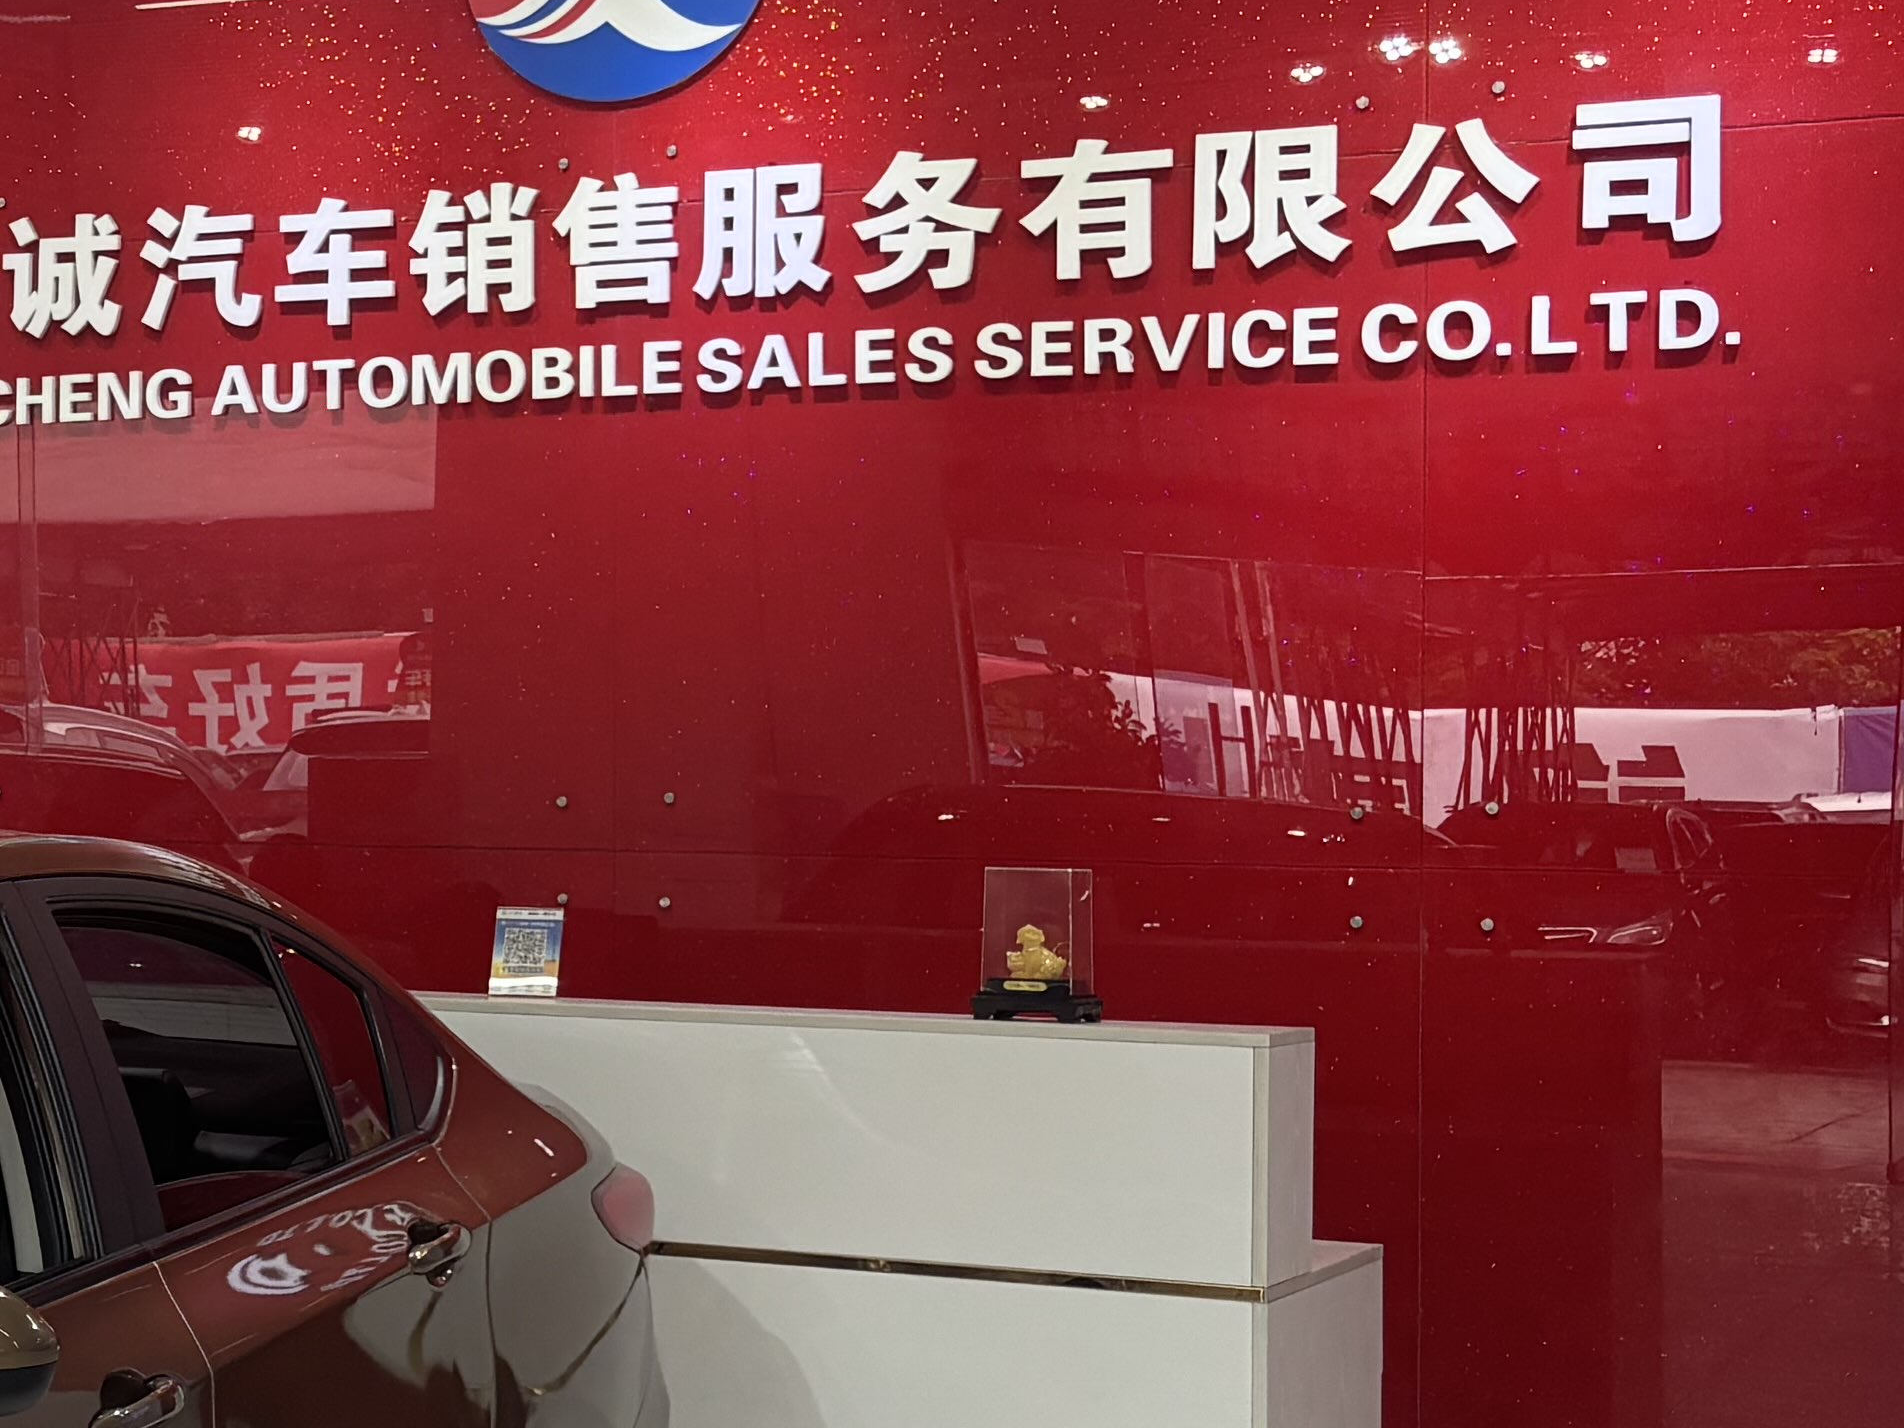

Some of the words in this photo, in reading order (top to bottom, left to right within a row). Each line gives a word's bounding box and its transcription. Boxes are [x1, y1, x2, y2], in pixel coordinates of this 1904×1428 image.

[211, 339, 684, 414] AUTOMOBILE
[695, 326, 956, 395] SALES
[974, 305, 1341, 381] SERVICE
